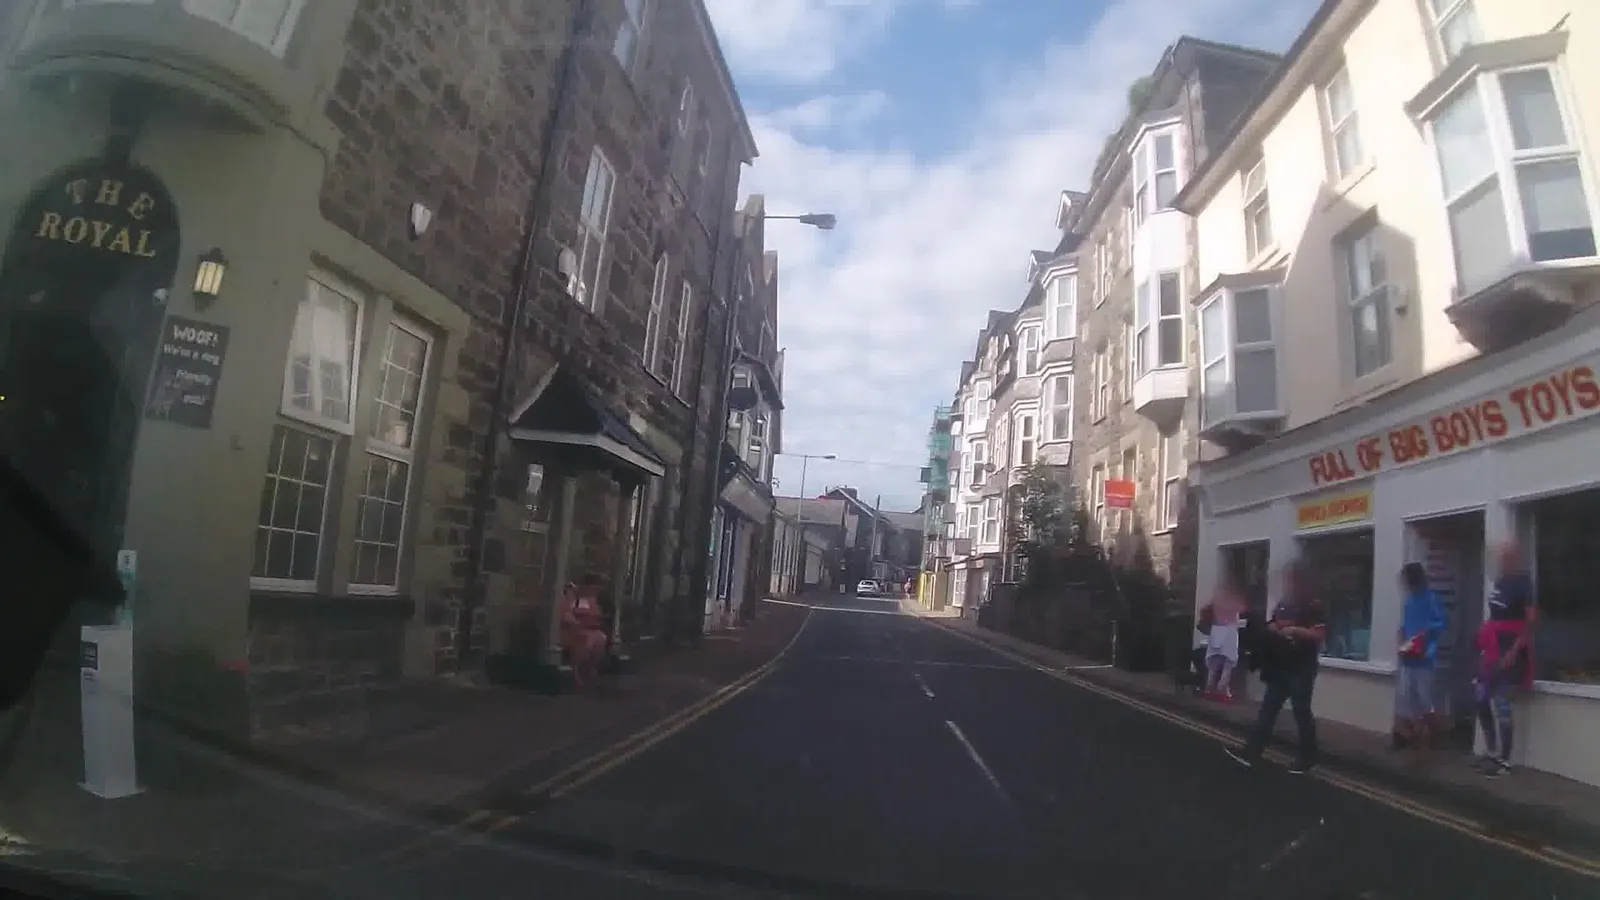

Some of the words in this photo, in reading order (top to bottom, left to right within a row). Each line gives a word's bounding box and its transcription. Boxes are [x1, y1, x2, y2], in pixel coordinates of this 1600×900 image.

[66, 178, 155, 219] THE
[36, 211, 156, 257] ROYAL
[1309, 450, 1355, 485] FULL
[1357, 437, 1384, 472] OF
[1389, 424, 1428, 463] BIG
[1430, 400, 1508, 452] BOYS
[1509, 366, 1600, 428] TOYS
